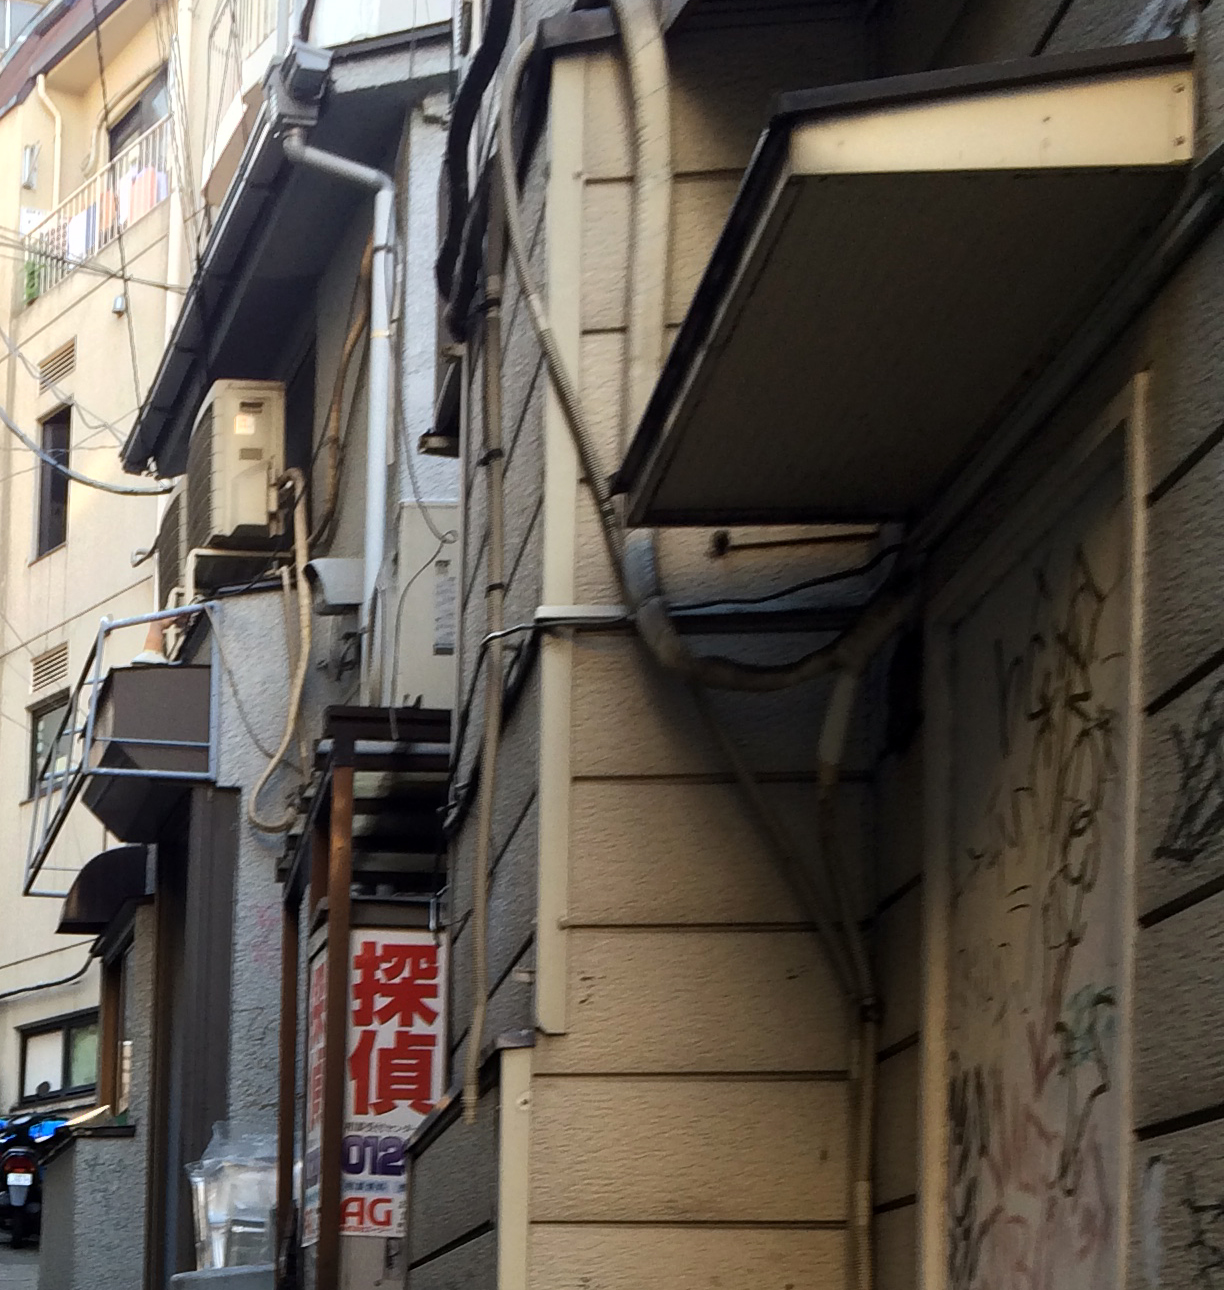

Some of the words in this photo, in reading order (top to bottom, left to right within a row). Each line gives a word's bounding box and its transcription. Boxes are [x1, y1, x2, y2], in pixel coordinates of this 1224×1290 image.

[348, 940, 439, 1116] 探偵
[341, 1135, 409, 1176] 012
[339, 1197, 393, 1227] AG
